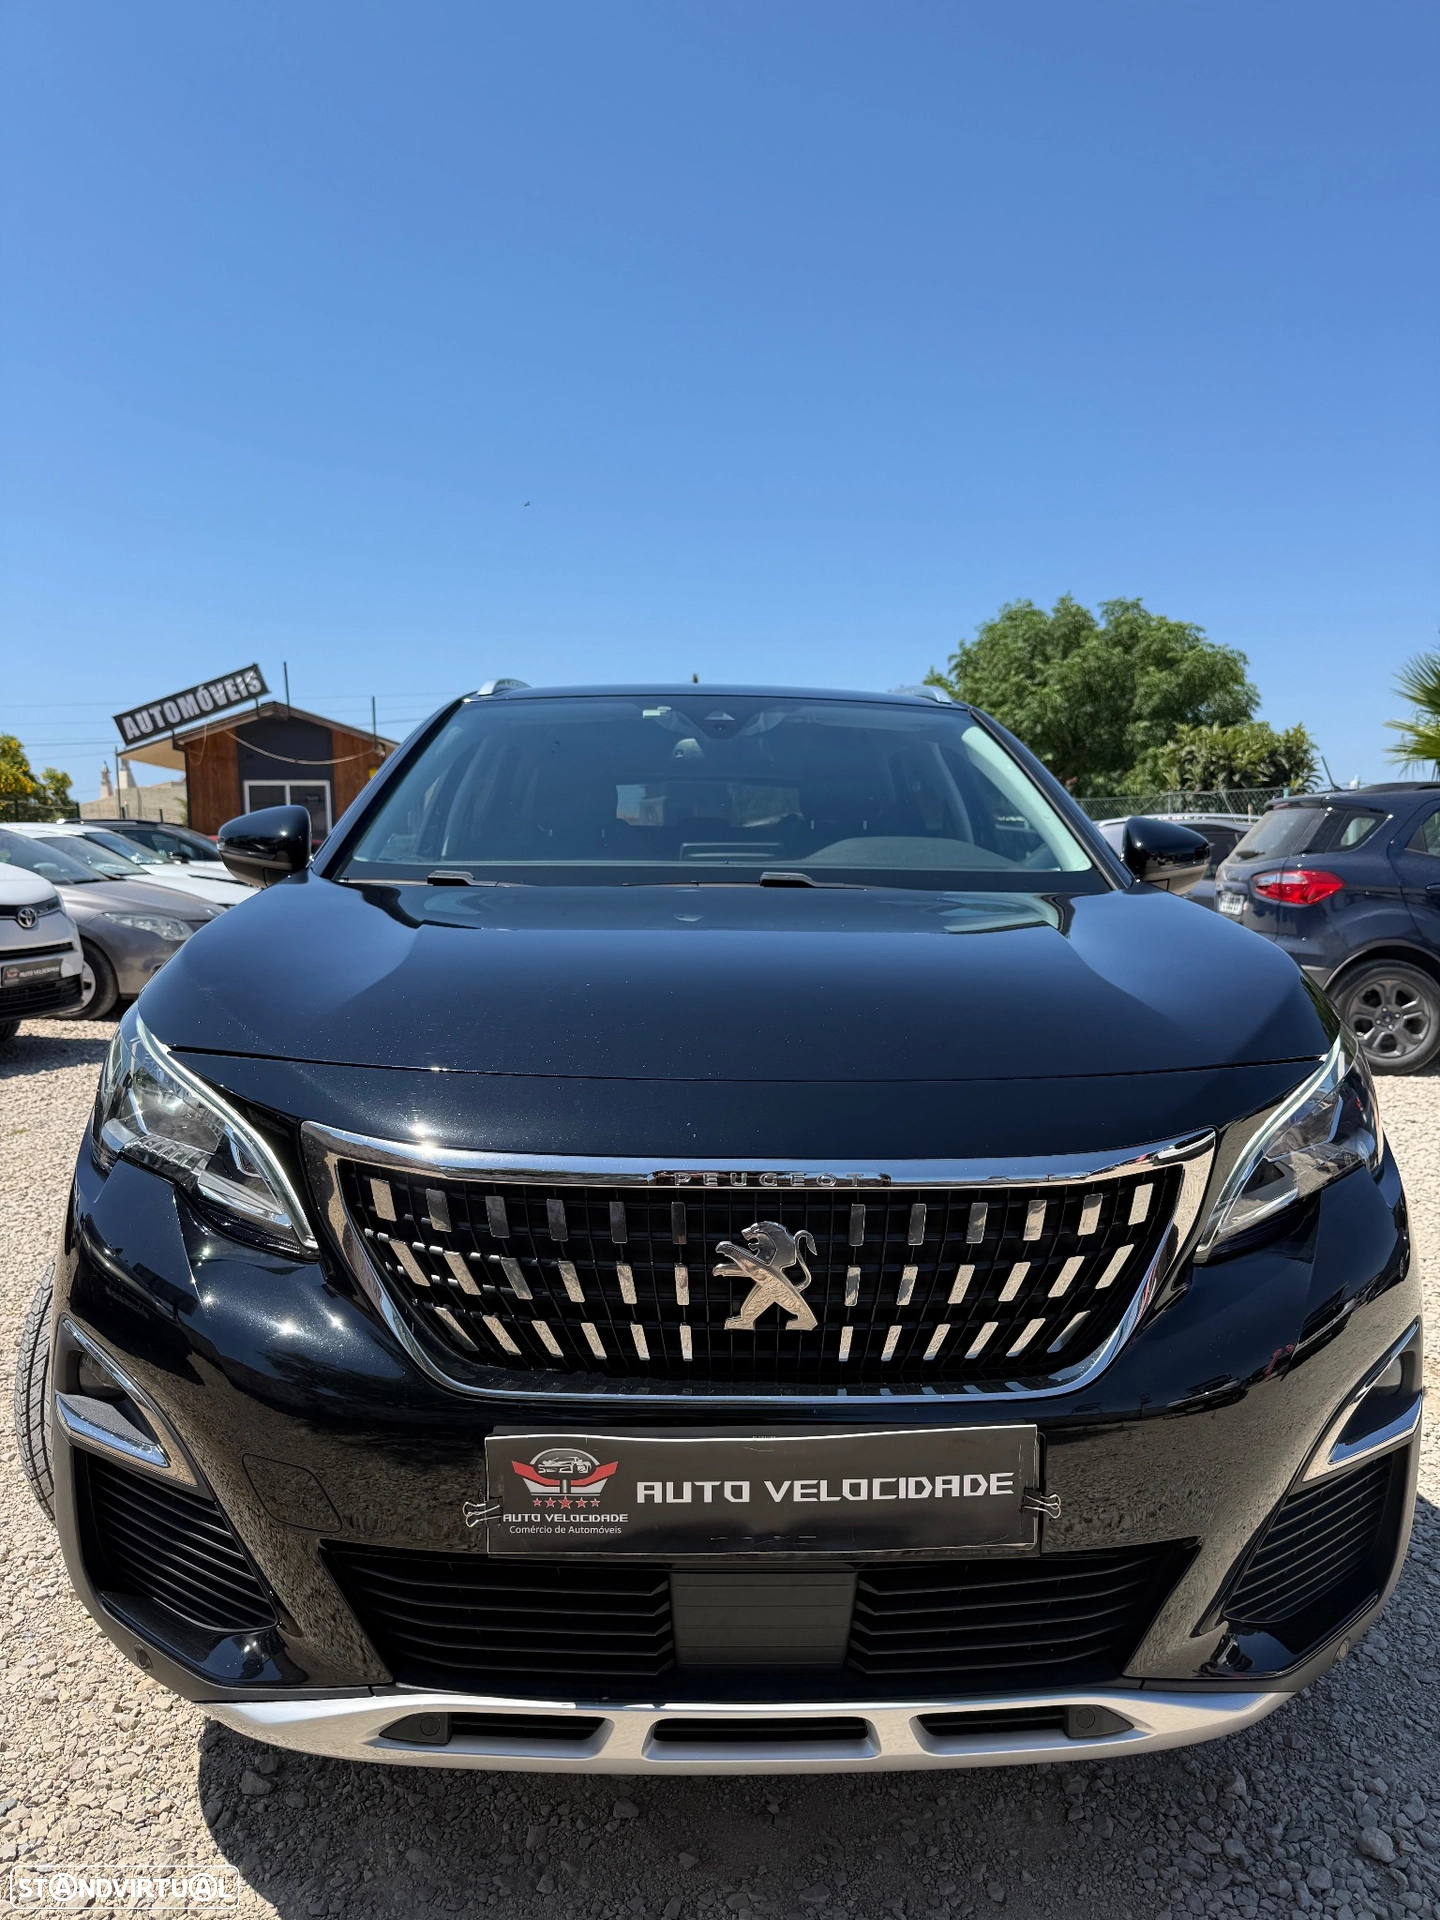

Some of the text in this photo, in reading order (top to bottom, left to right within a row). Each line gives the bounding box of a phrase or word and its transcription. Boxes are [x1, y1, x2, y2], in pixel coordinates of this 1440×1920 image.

[121, 669, 263, 741] AUTOMÓVEIS
[674, 1172, 865, 1188] PEUGEOT
[636, 1472, 1015, 1504] AUTO VELOCIDADE
[502, 1513, 629, 1523] AUTO VELOCIDADE
[509, 1525, 622, 1534] Comércio de Automóveis
